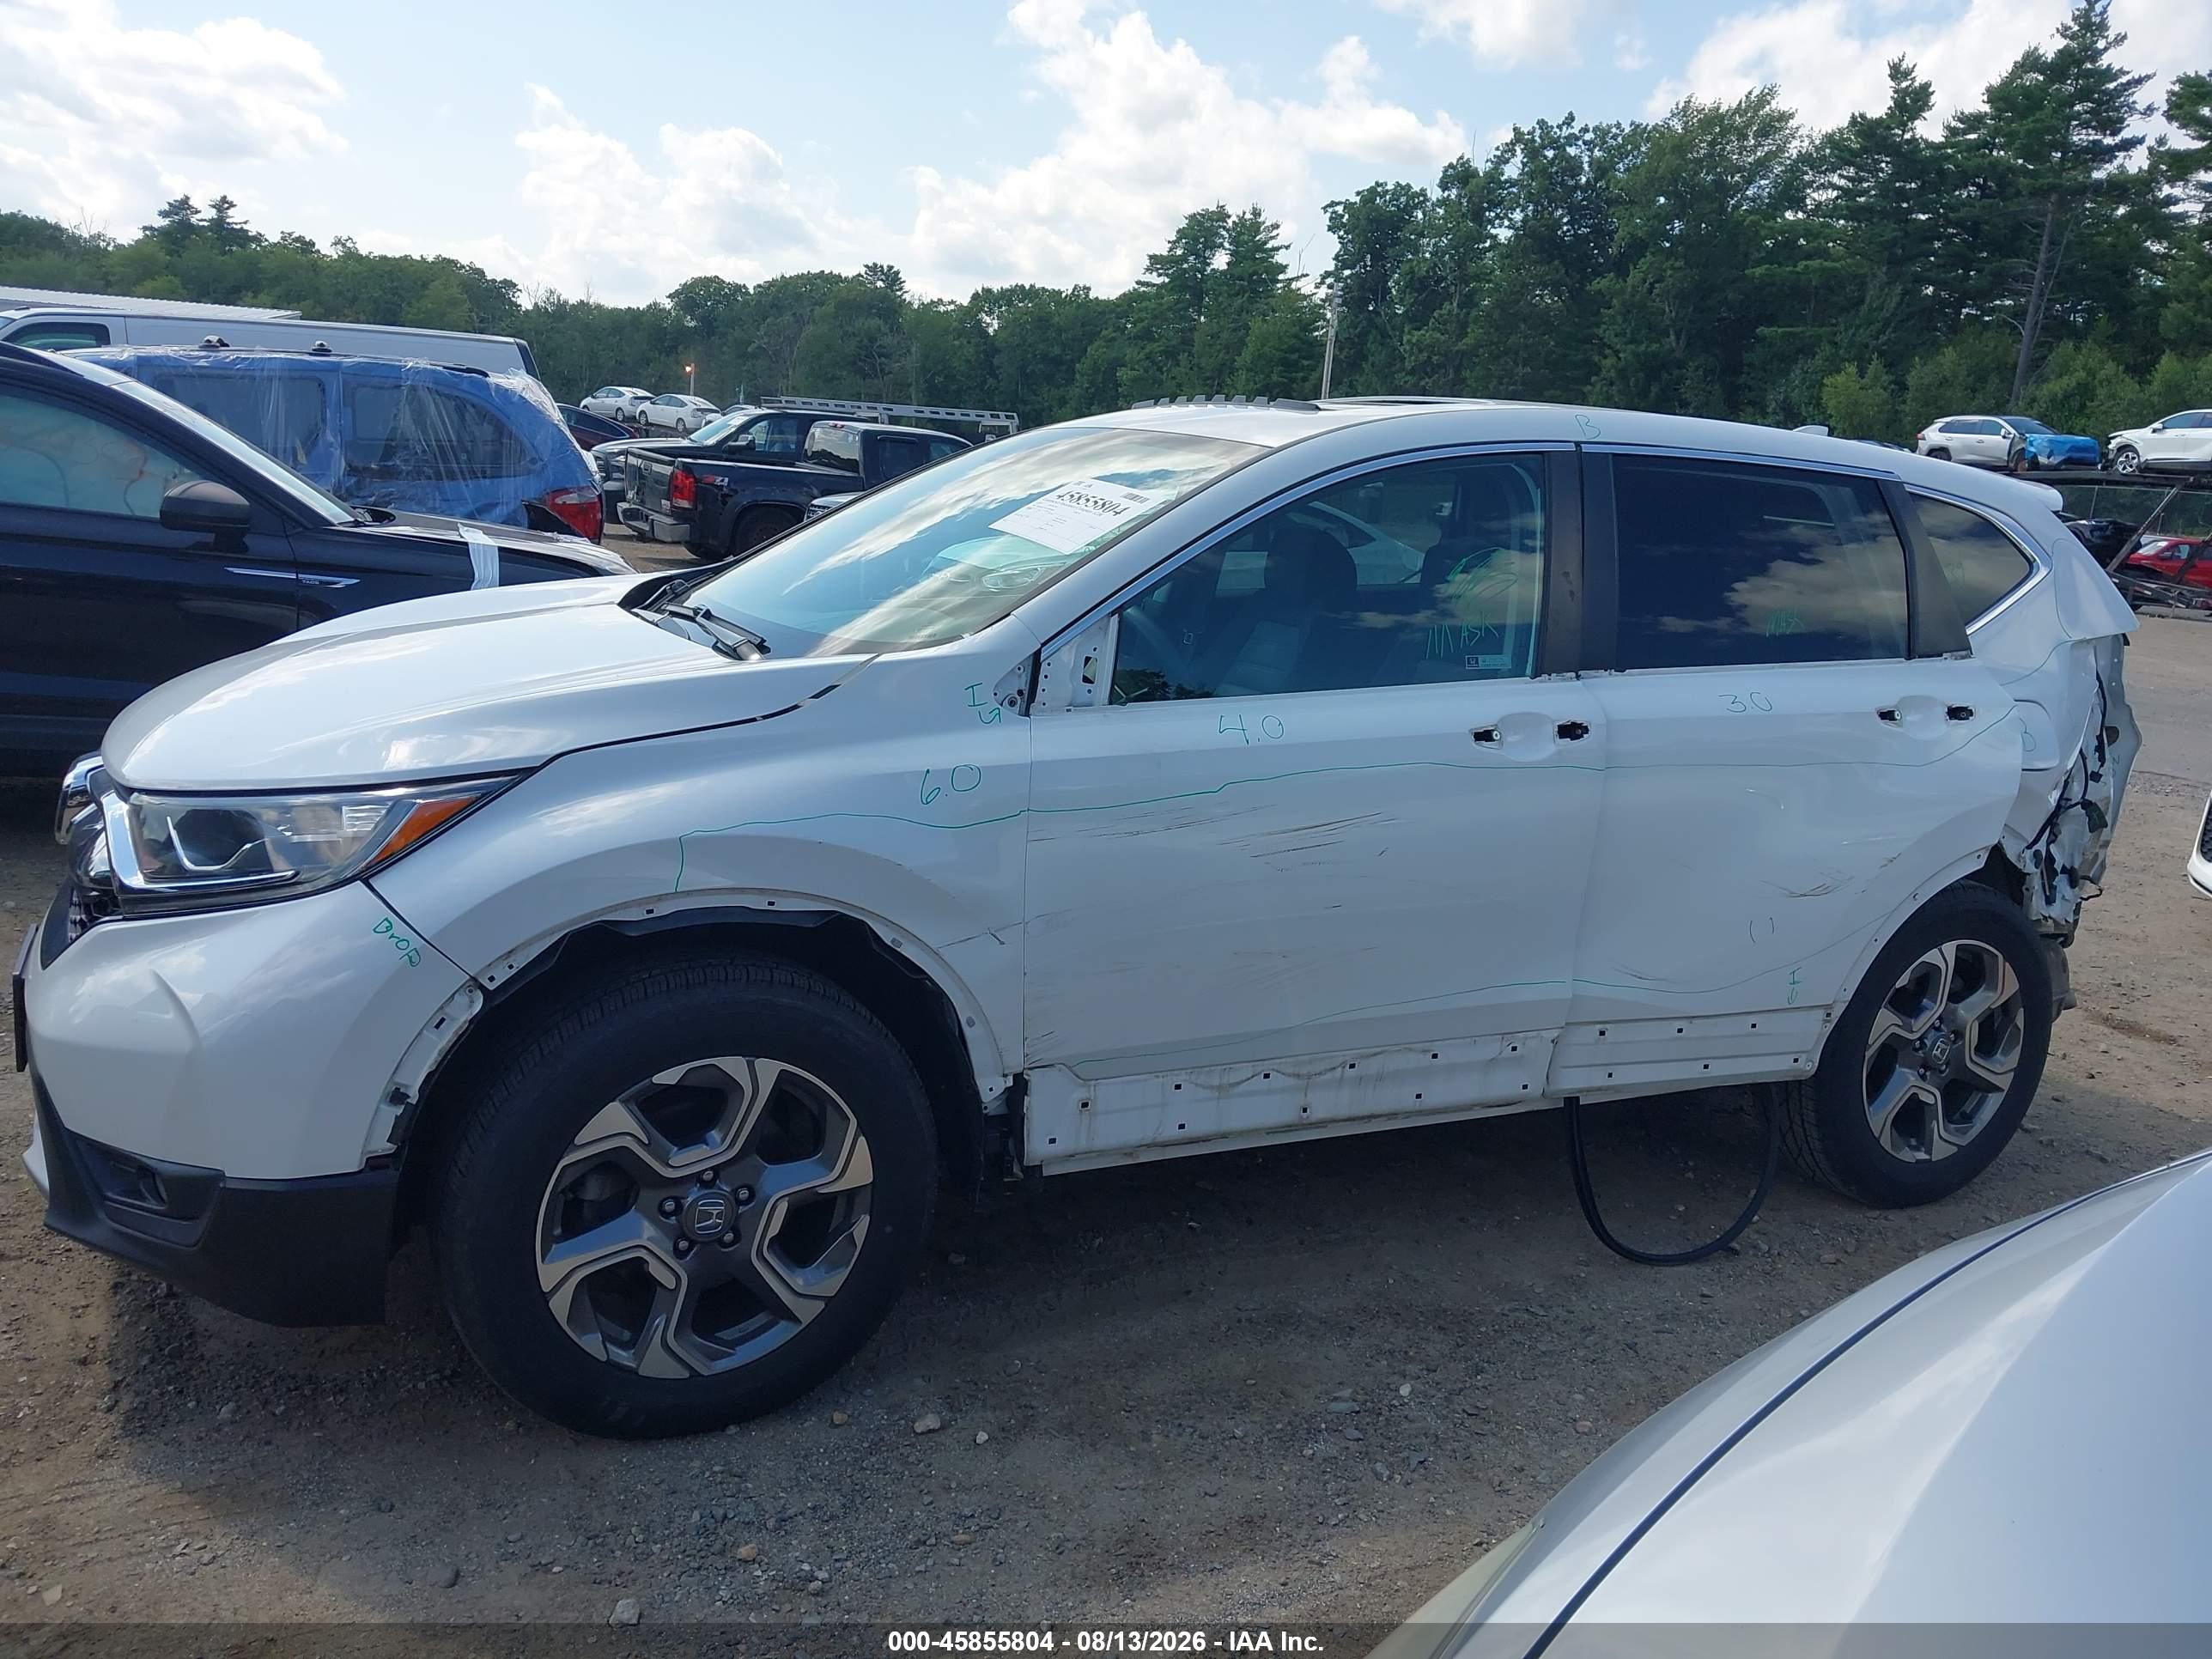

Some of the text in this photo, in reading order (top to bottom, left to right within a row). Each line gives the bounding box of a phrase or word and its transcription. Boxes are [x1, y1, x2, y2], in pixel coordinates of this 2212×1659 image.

[1055, 490, 1132, 517] 45855804
[1218, 714, 1285, 745] 4.0
[921, 763, 981, 805] 6.0
